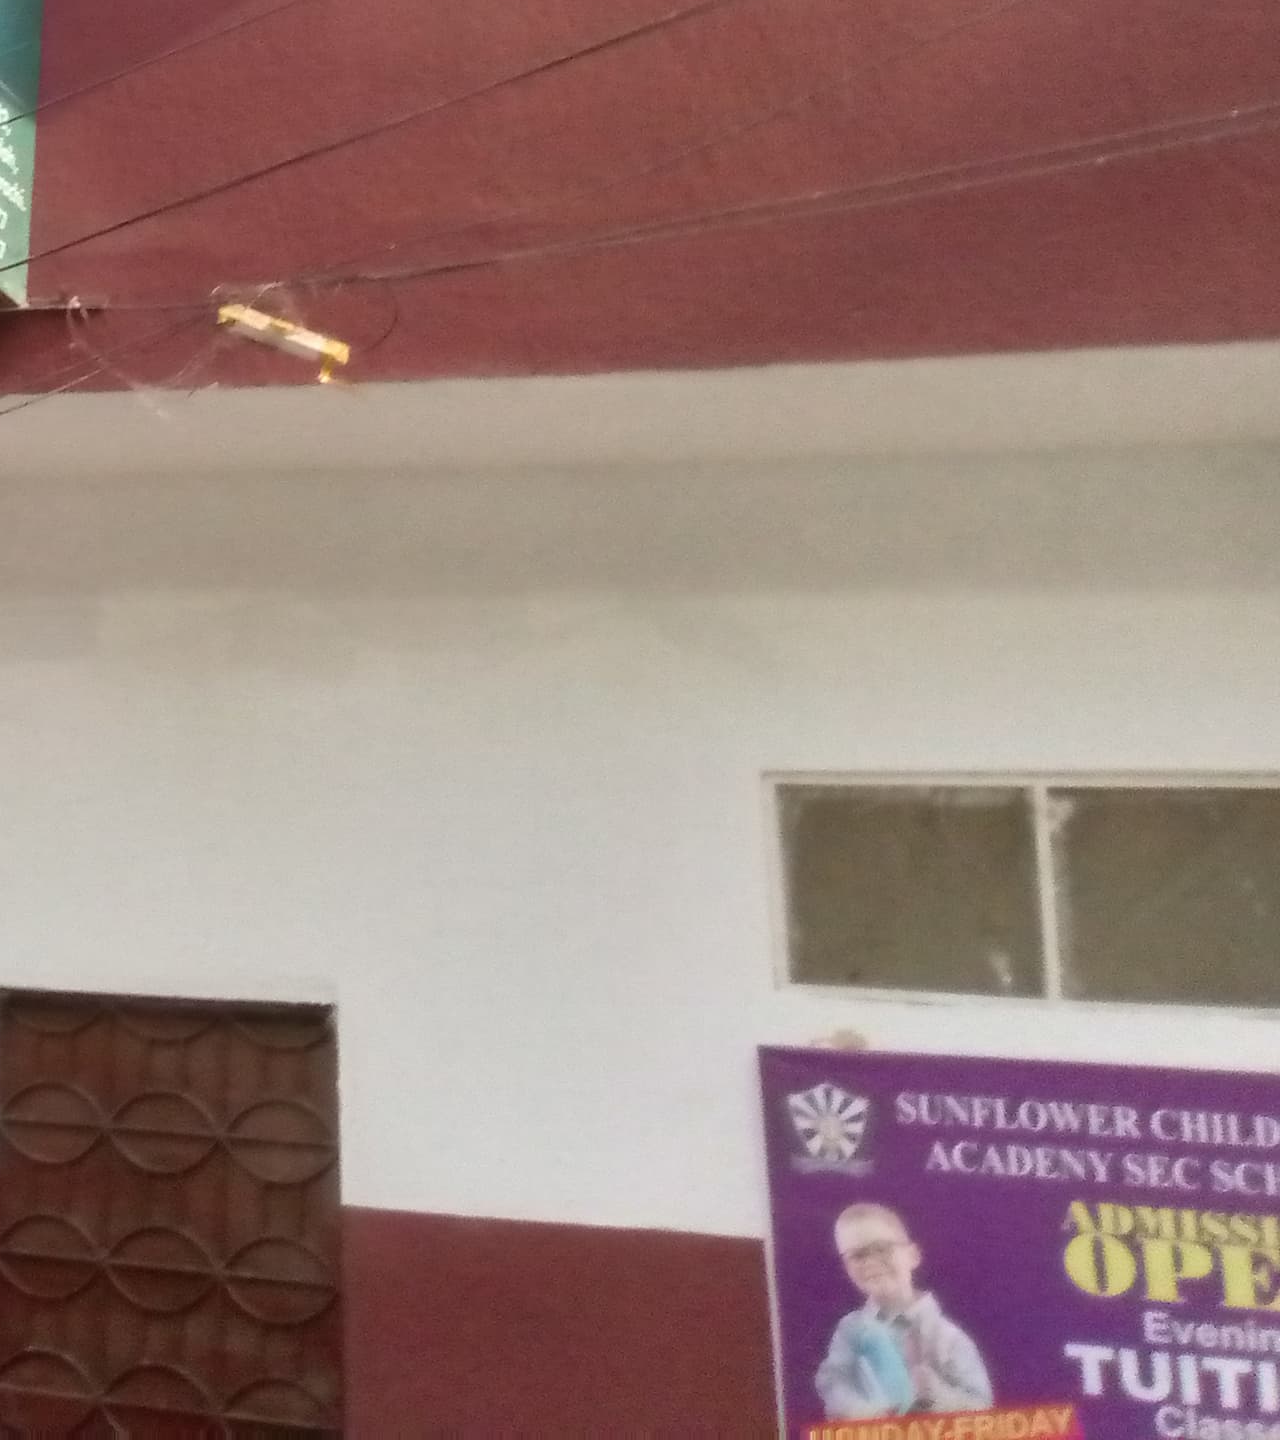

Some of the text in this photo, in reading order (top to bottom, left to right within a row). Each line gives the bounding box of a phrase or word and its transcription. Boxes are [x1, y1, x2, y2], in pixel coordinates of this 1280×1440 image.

[894, 1091, 1140, 1140] SUNFLOWER
[925, 1141, 1114, 1184] ACADENY
[1121, 1153, 1202, 1191] SEC
